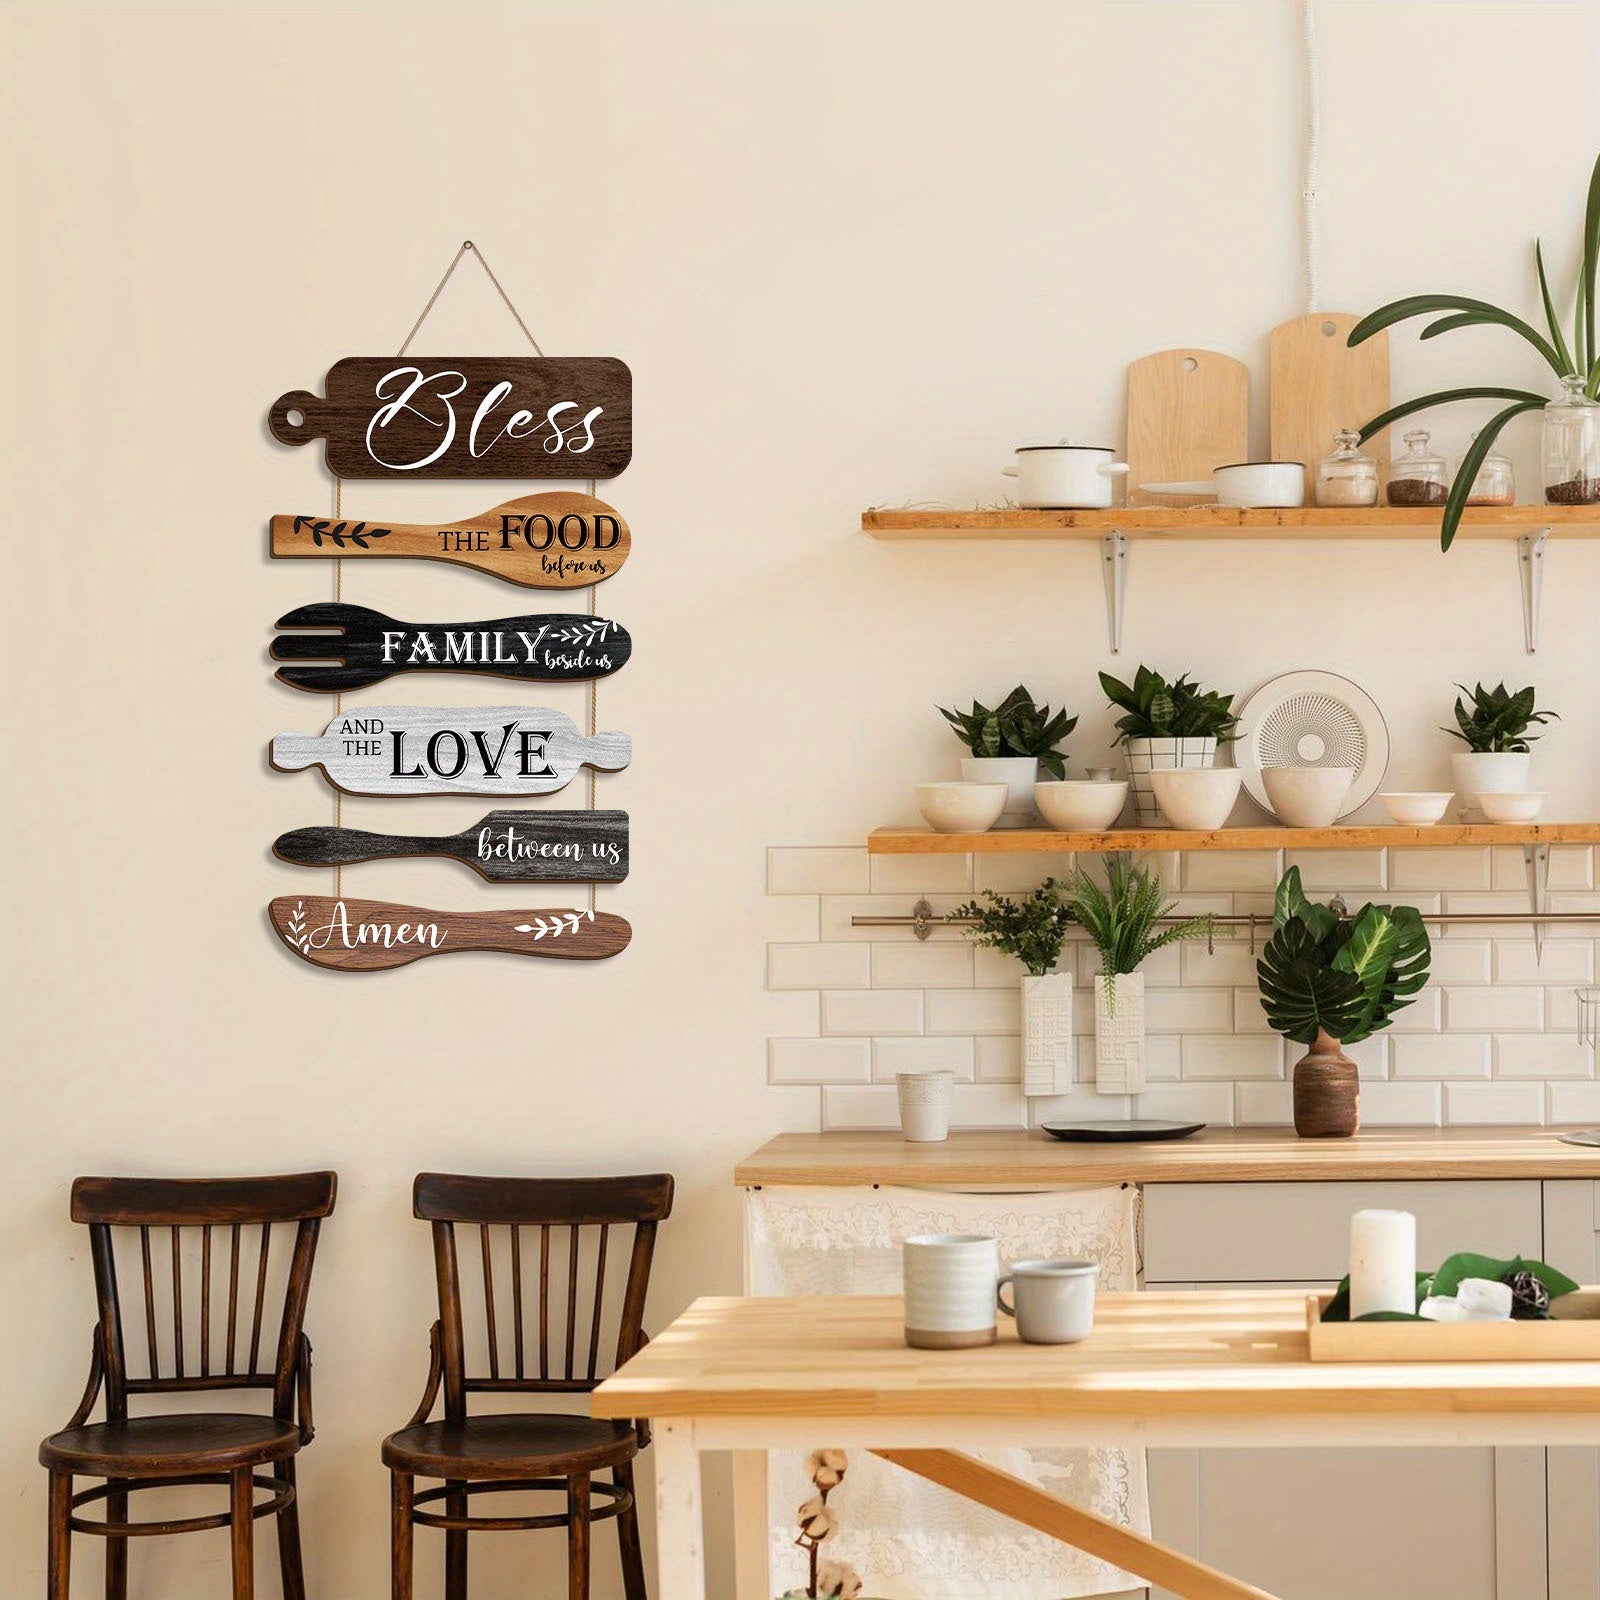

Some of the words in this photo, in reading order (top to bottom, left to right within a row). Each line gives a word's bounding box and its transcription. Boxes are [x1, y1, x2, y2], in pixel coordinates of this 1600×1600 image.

[366, 366, 604, 470] Bless
[438, 531, 490, 551] THE
[498, 514, 622, 552] FOOD
[541, 555, 587, 579] before
[589, 560, 607, 574] us
[380, 625, 551, 664] FAMILY
[545, 650, 594, 669] beside
[595, 655, 613, 670] us
[340, 719, 384, 735] AND
[342, 740, 382, 756] THE
[389, 720, 559, 781] LOVE
[477, 826, 585, 862] between
[592, 842, 624, 865] us
[308, 900, 448, 949] Amen
